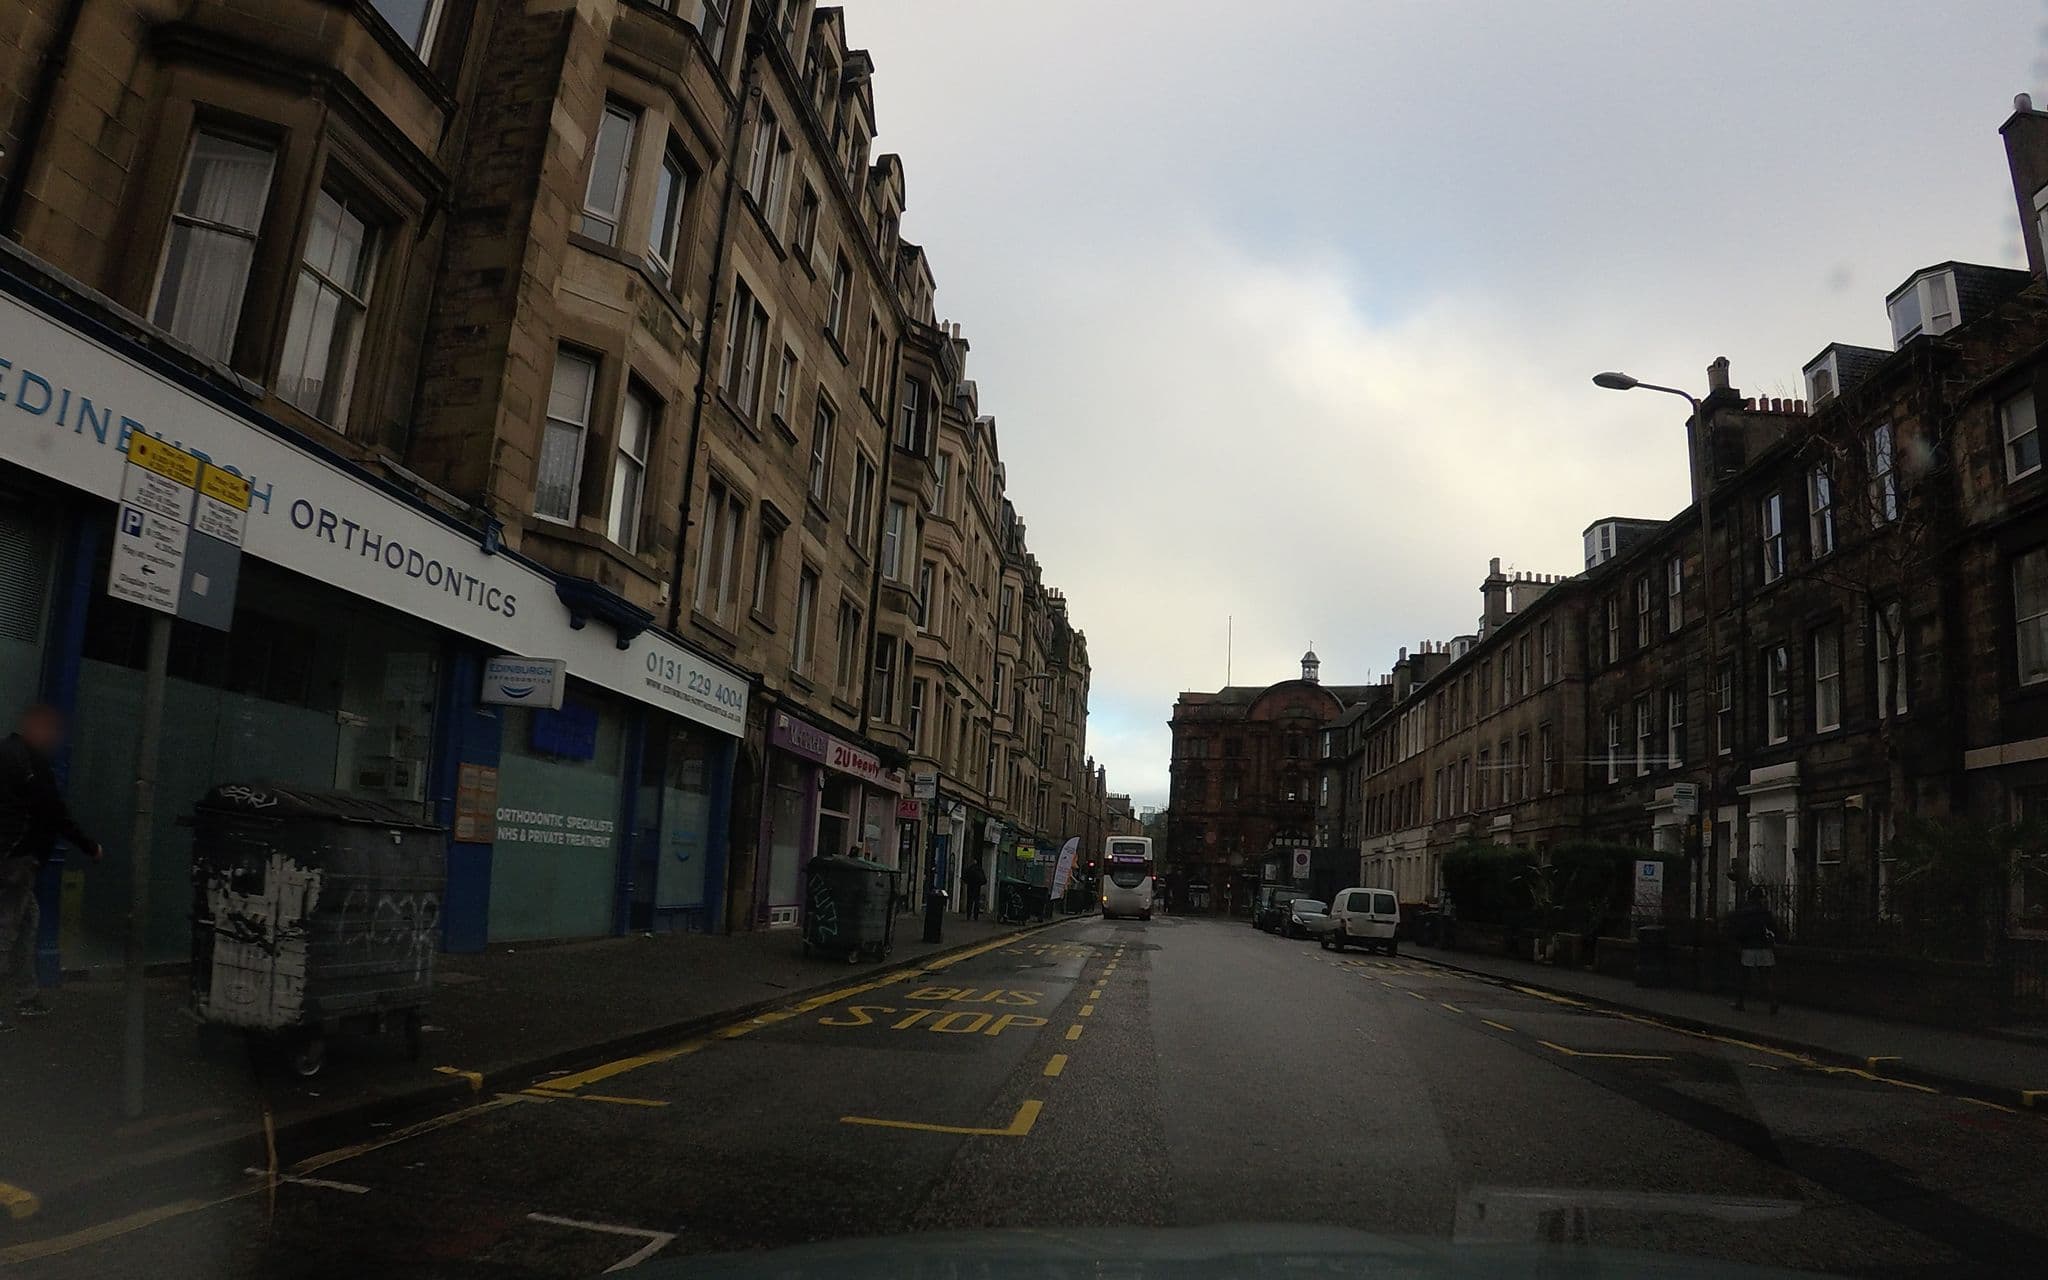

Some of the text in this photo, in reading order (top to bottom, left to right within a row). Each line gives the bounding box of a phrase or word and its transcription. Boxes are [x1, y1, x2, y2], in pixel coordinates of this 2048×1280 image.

[290, 499, 517, 617] ORTHODONTICS
[488, 663, 553, 676] EDINBURGH
[646, 652, 743, 711] 0131 229 4004
[834, 746, 851, 768] 2U
[852, 754, 880, 779] Beauty
[496, 808, 614, 832] ORTHODONTIC SPECIALISTS
[498, 827, 518, 841] NHS
[528, 829, 564, 845] PRIVATE
[565, 833, 611, 848] TREATMENT
[904, 986, 1044, 1006] BUS
[818, 1005, 1049, 1037] STOP
